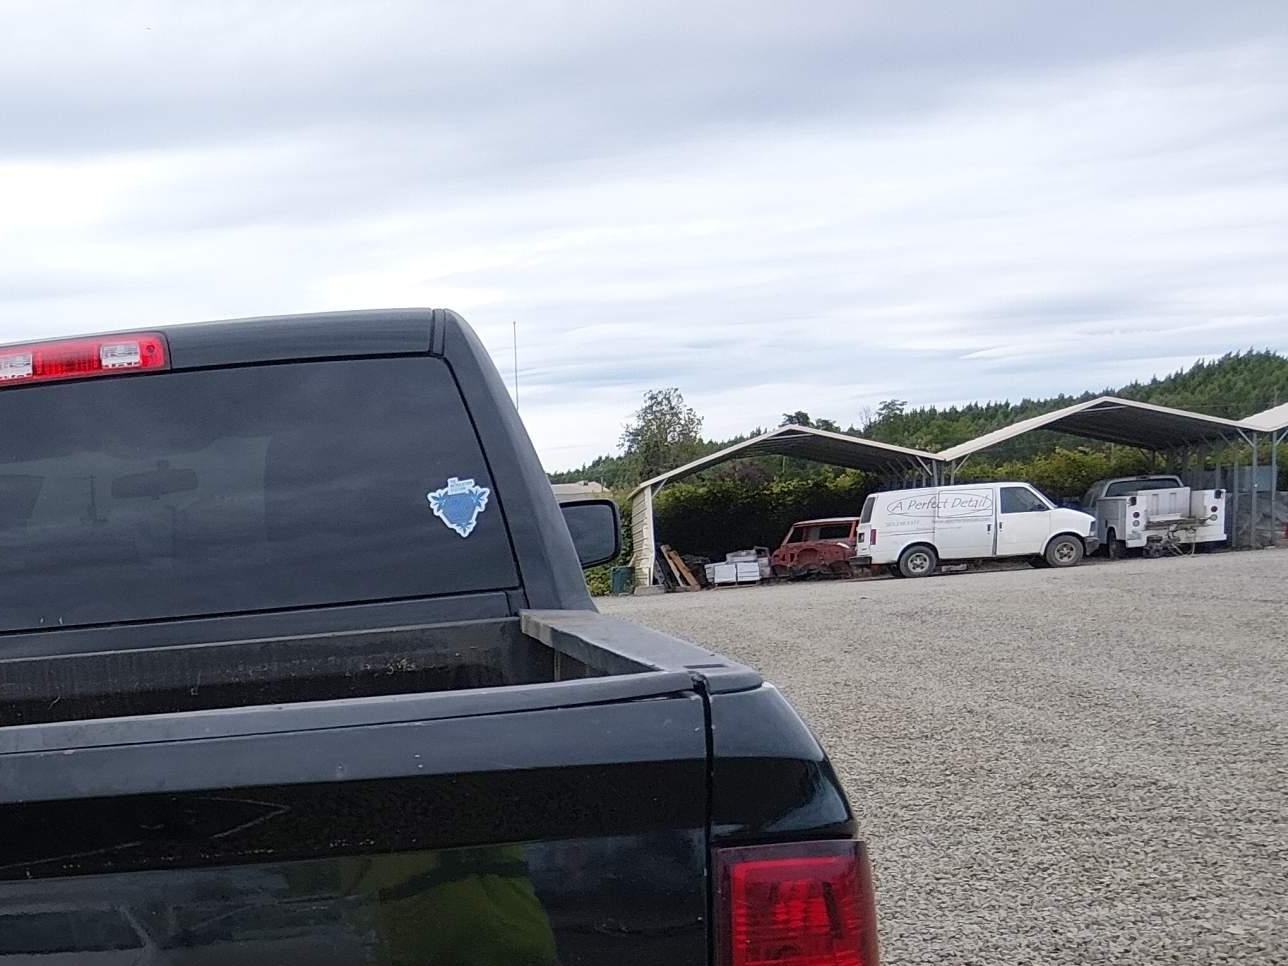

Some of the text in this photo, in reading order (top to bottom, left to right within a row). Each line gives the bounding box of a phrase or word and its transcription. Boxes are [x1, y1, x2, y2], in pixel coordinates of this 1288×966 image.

[892, 495, 988, 511] A Perfect Detail
